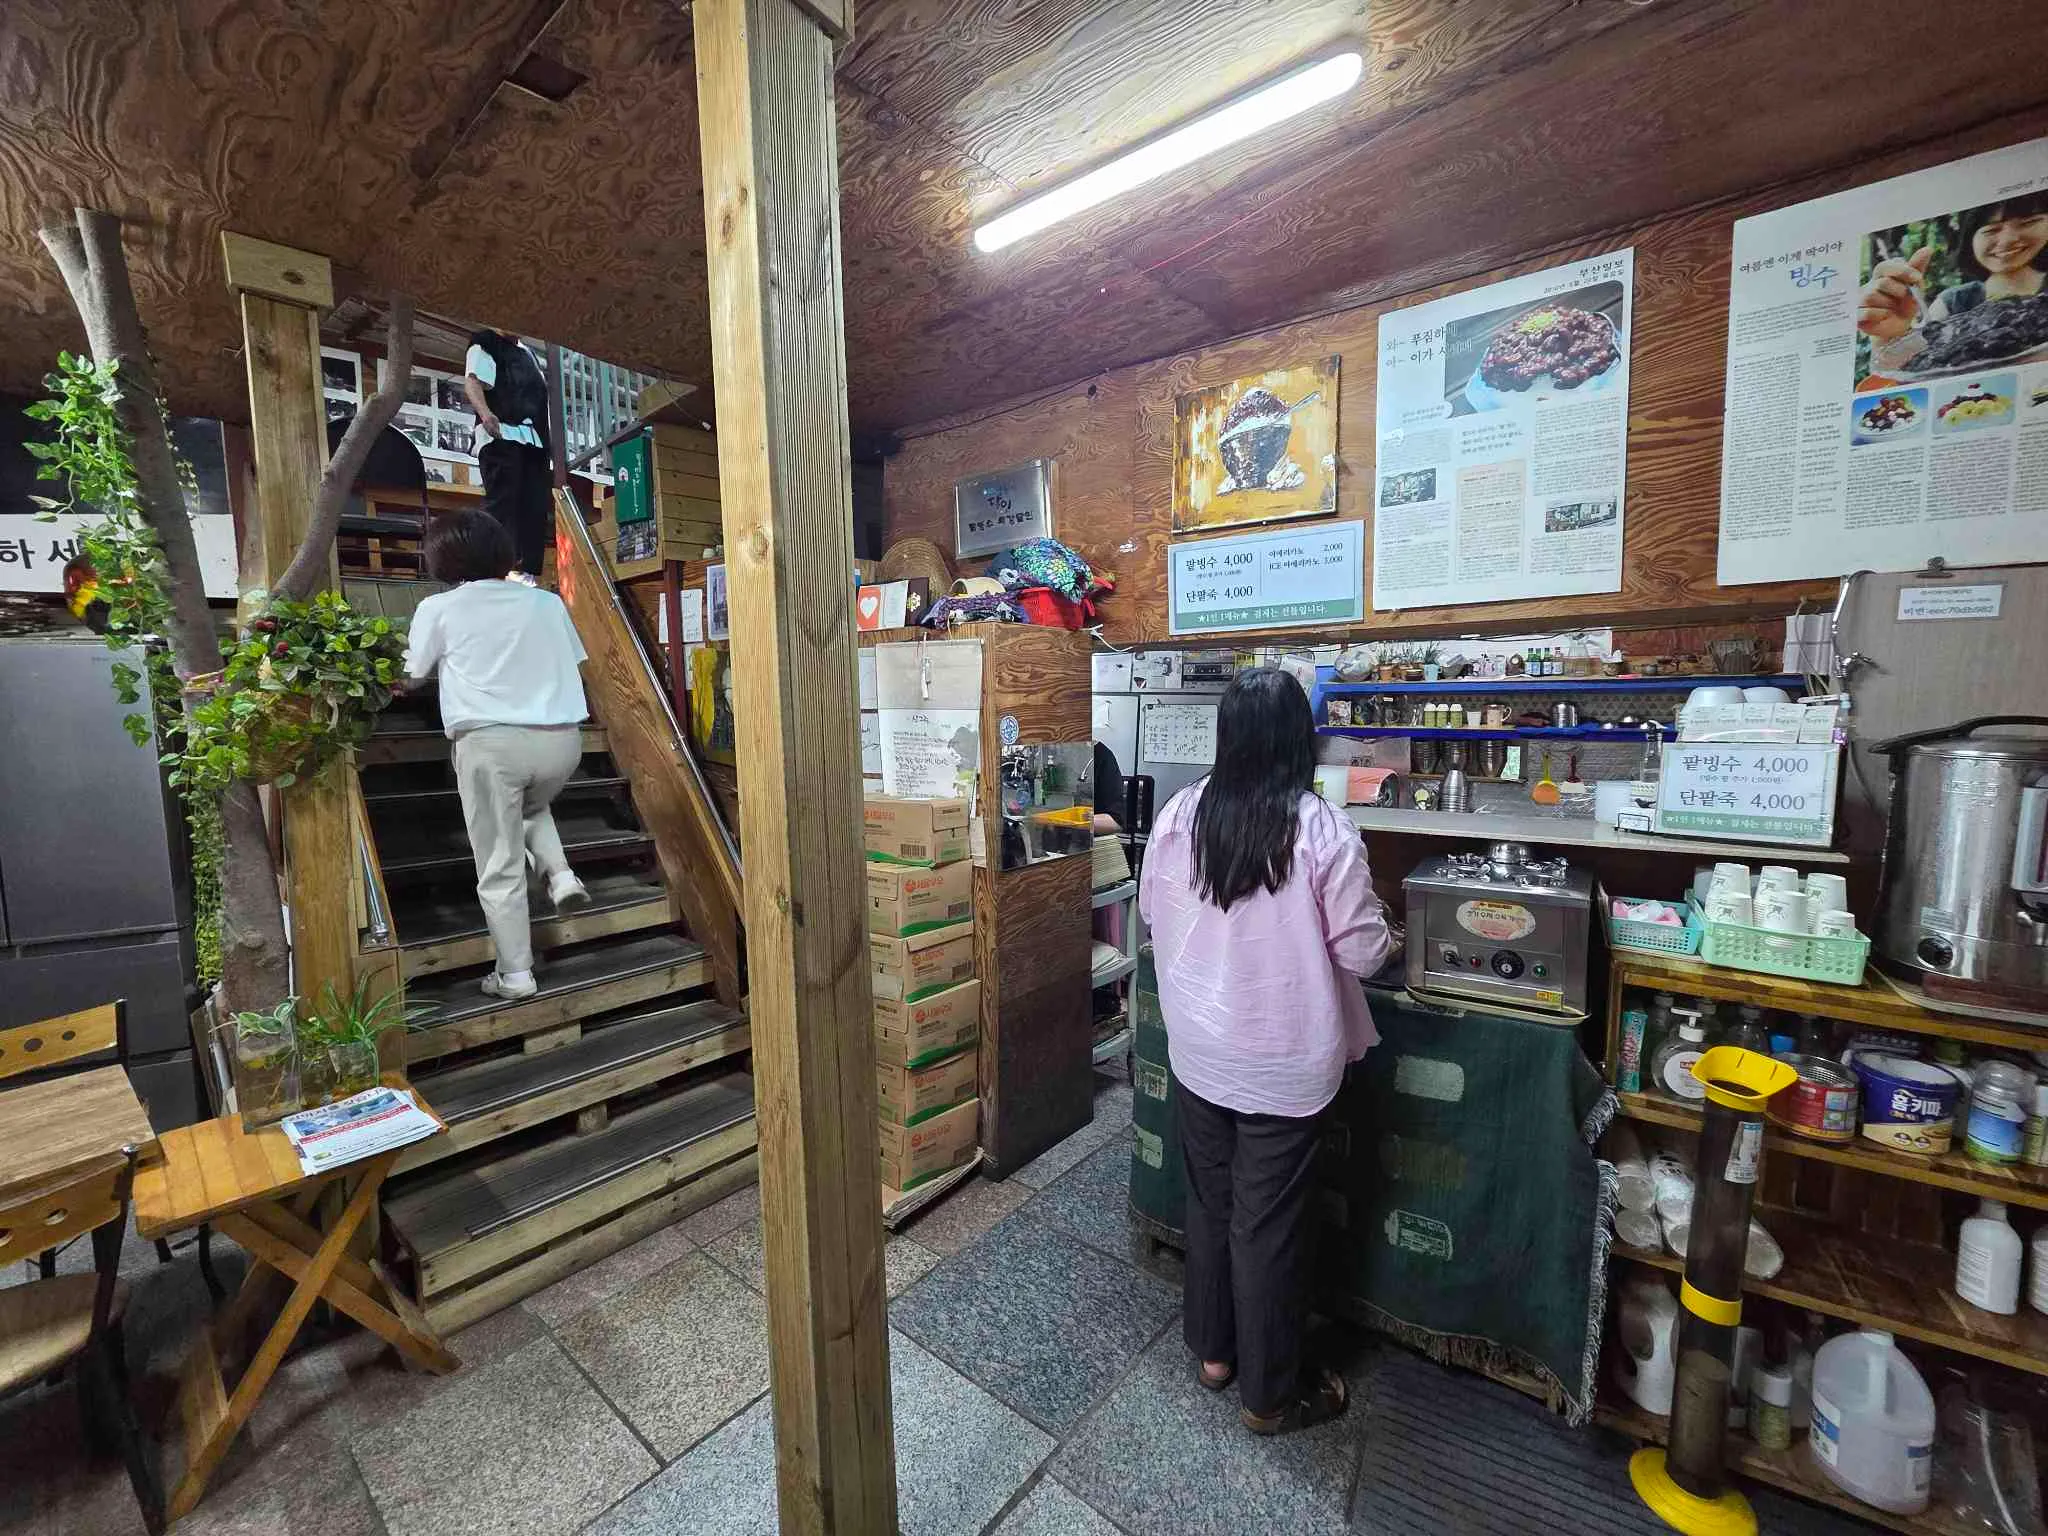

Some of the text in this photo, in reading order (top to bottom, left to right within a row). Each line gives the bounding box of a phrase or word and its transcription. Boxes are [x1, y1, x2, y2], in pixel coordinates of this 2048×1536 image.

[1740, 241, 1843, 273] 여름엔 이게 딱이야
[1790, 263, 1840, 288] 빙수
[1410, 347, 1432, 366] 이가
[1186, 552, 1253, 571] 팥빙수 4,000
[1187, 586, 1253, 603] 단팥죽 4,000
[1682, 755, 1808, 774] 팥빙수 4,000
[1680, 788, 1805, 811] 단팥죽 4,000
[1891, 1089, 1942, 1117] 홈키파
